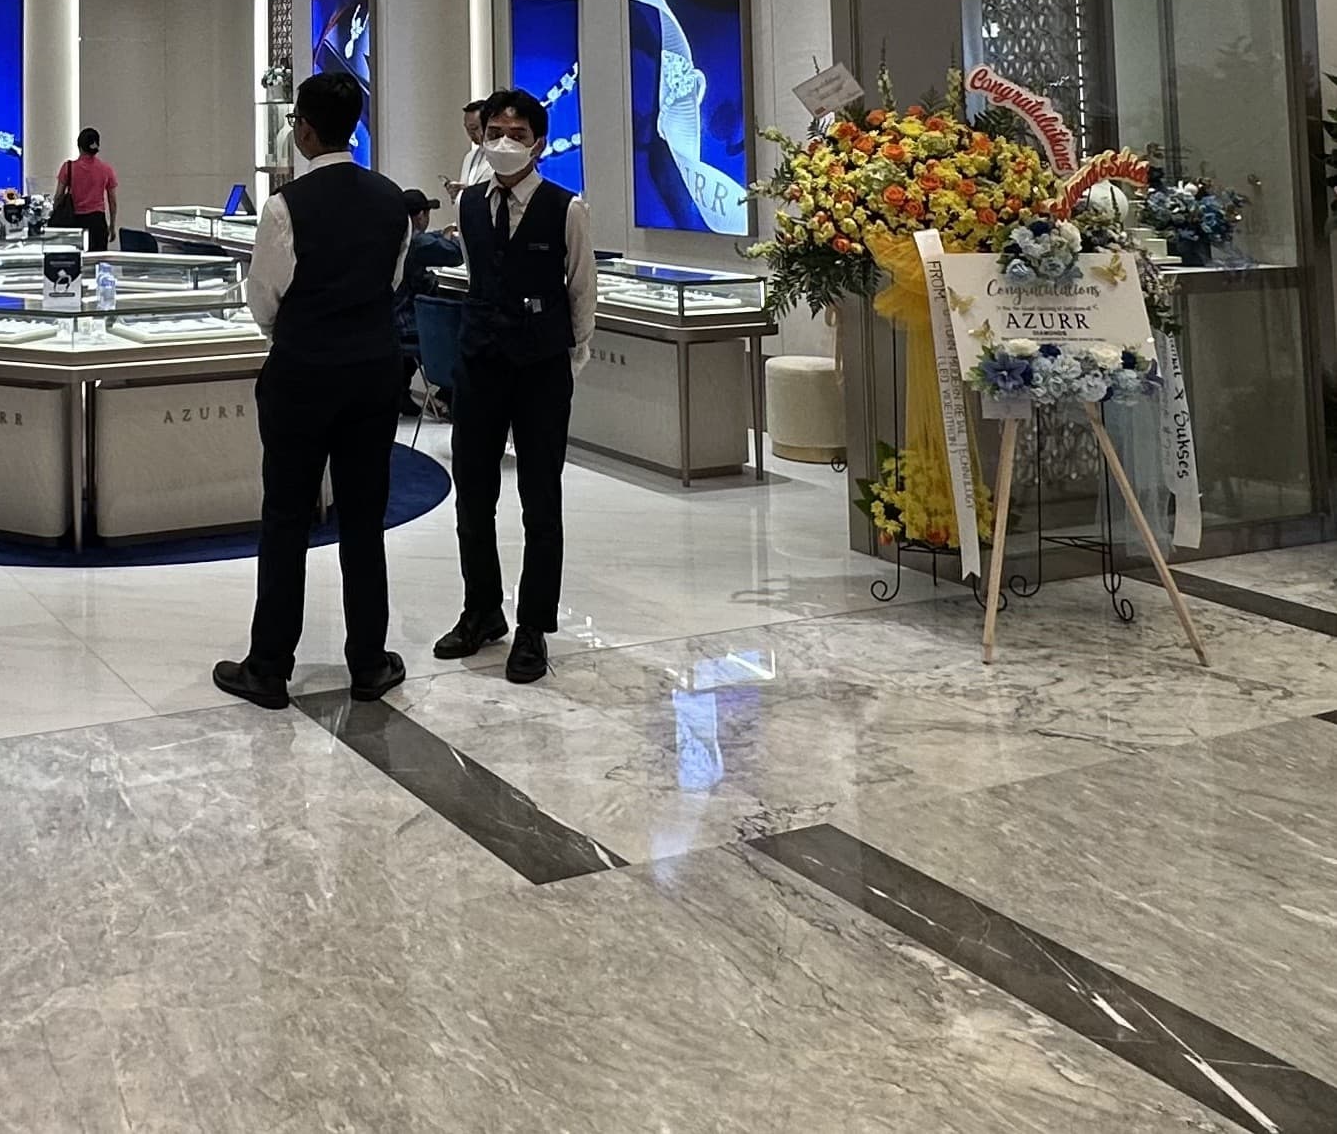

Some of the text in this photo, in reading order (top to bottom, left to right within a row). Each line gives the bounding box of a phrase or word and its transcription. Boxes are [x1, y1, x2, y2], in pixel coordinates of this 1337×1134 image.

[970, 68, 1074, 171] Congratulations
[1006, 312, 1090, 330] AZURR
[590, 348, 627, 366] ZURR
[164, 404, 246, 425] AZURR
